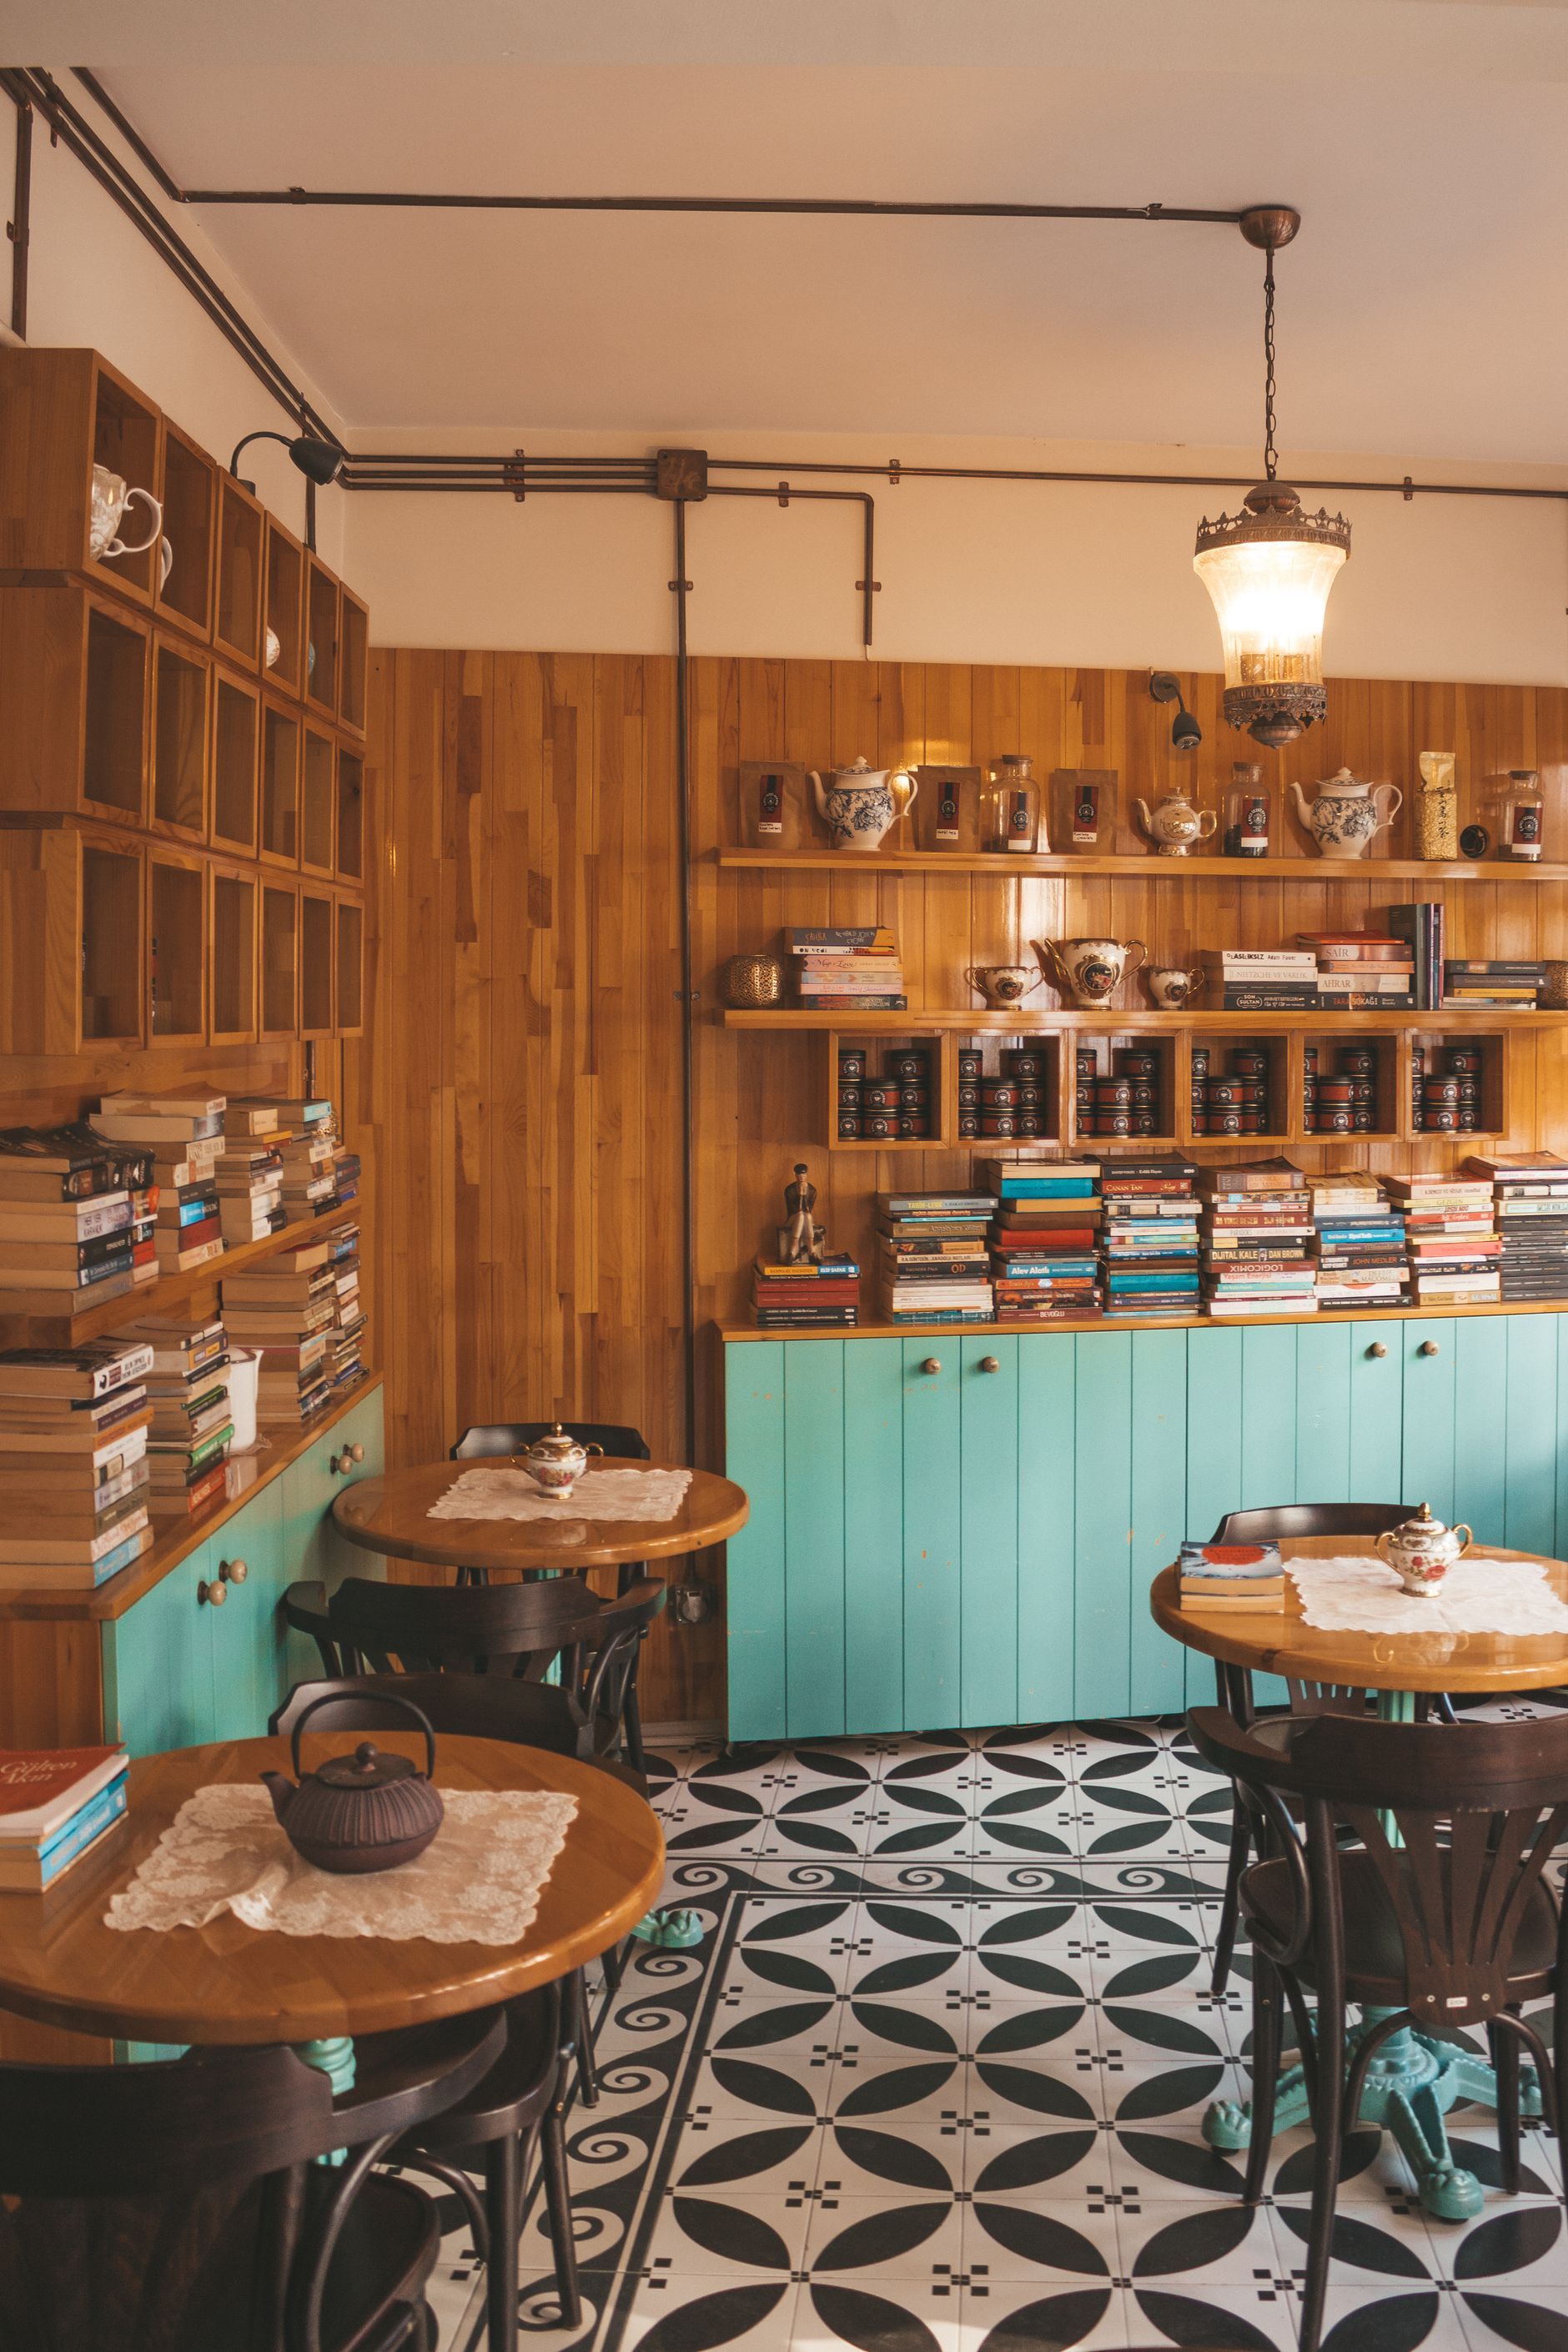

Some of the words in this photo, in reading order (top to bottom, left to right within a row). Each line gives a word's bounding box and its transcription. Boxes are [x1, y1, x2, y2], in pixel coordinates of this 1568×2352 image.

[1239, 1250, 1258, 1259] KALE
[1269, 1250, 1281, 1259] DAN
[1282, 1249, 1304, 1259] BROWN
[1011, 1267, 1029, 1275] Alev
[1229, 1264, 1284, 1273] LOGICOMIX
